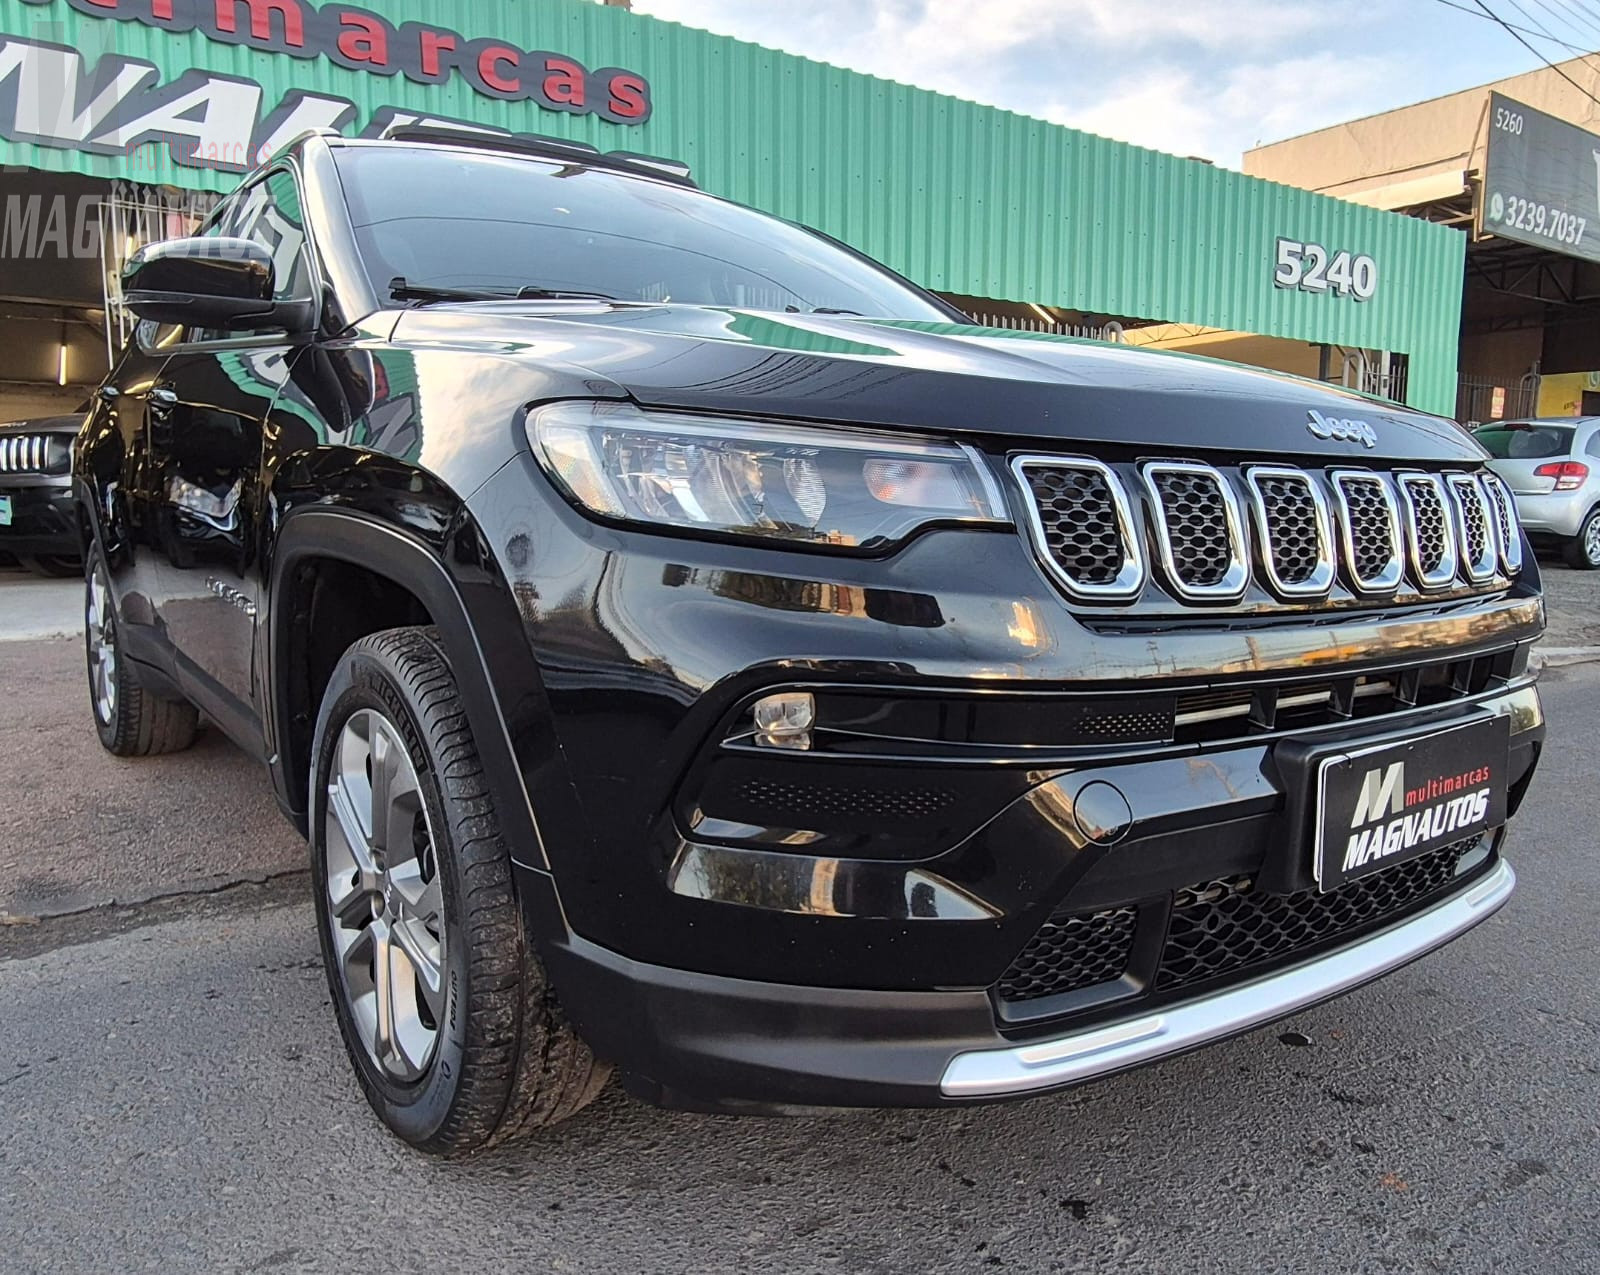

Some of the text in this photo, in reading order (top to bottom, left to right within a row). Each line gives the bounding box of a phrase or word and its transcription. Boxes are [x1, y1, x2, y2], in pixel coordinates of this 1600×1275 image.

[86, 0, 645, 118] marcas
[1495, 107, 1523, 135] 5260
[1505, 195, 1586, 245] 3239.7037
[1274, 239, 1377, 299] 5240
[1306, 409, 1377, 449] Jeep
[369, 672, 425, 770] MICHELIN
[1405, 765, 1490, 807] multimarcas
[1341, 788, 1491, 872] MAGNAUTOS
